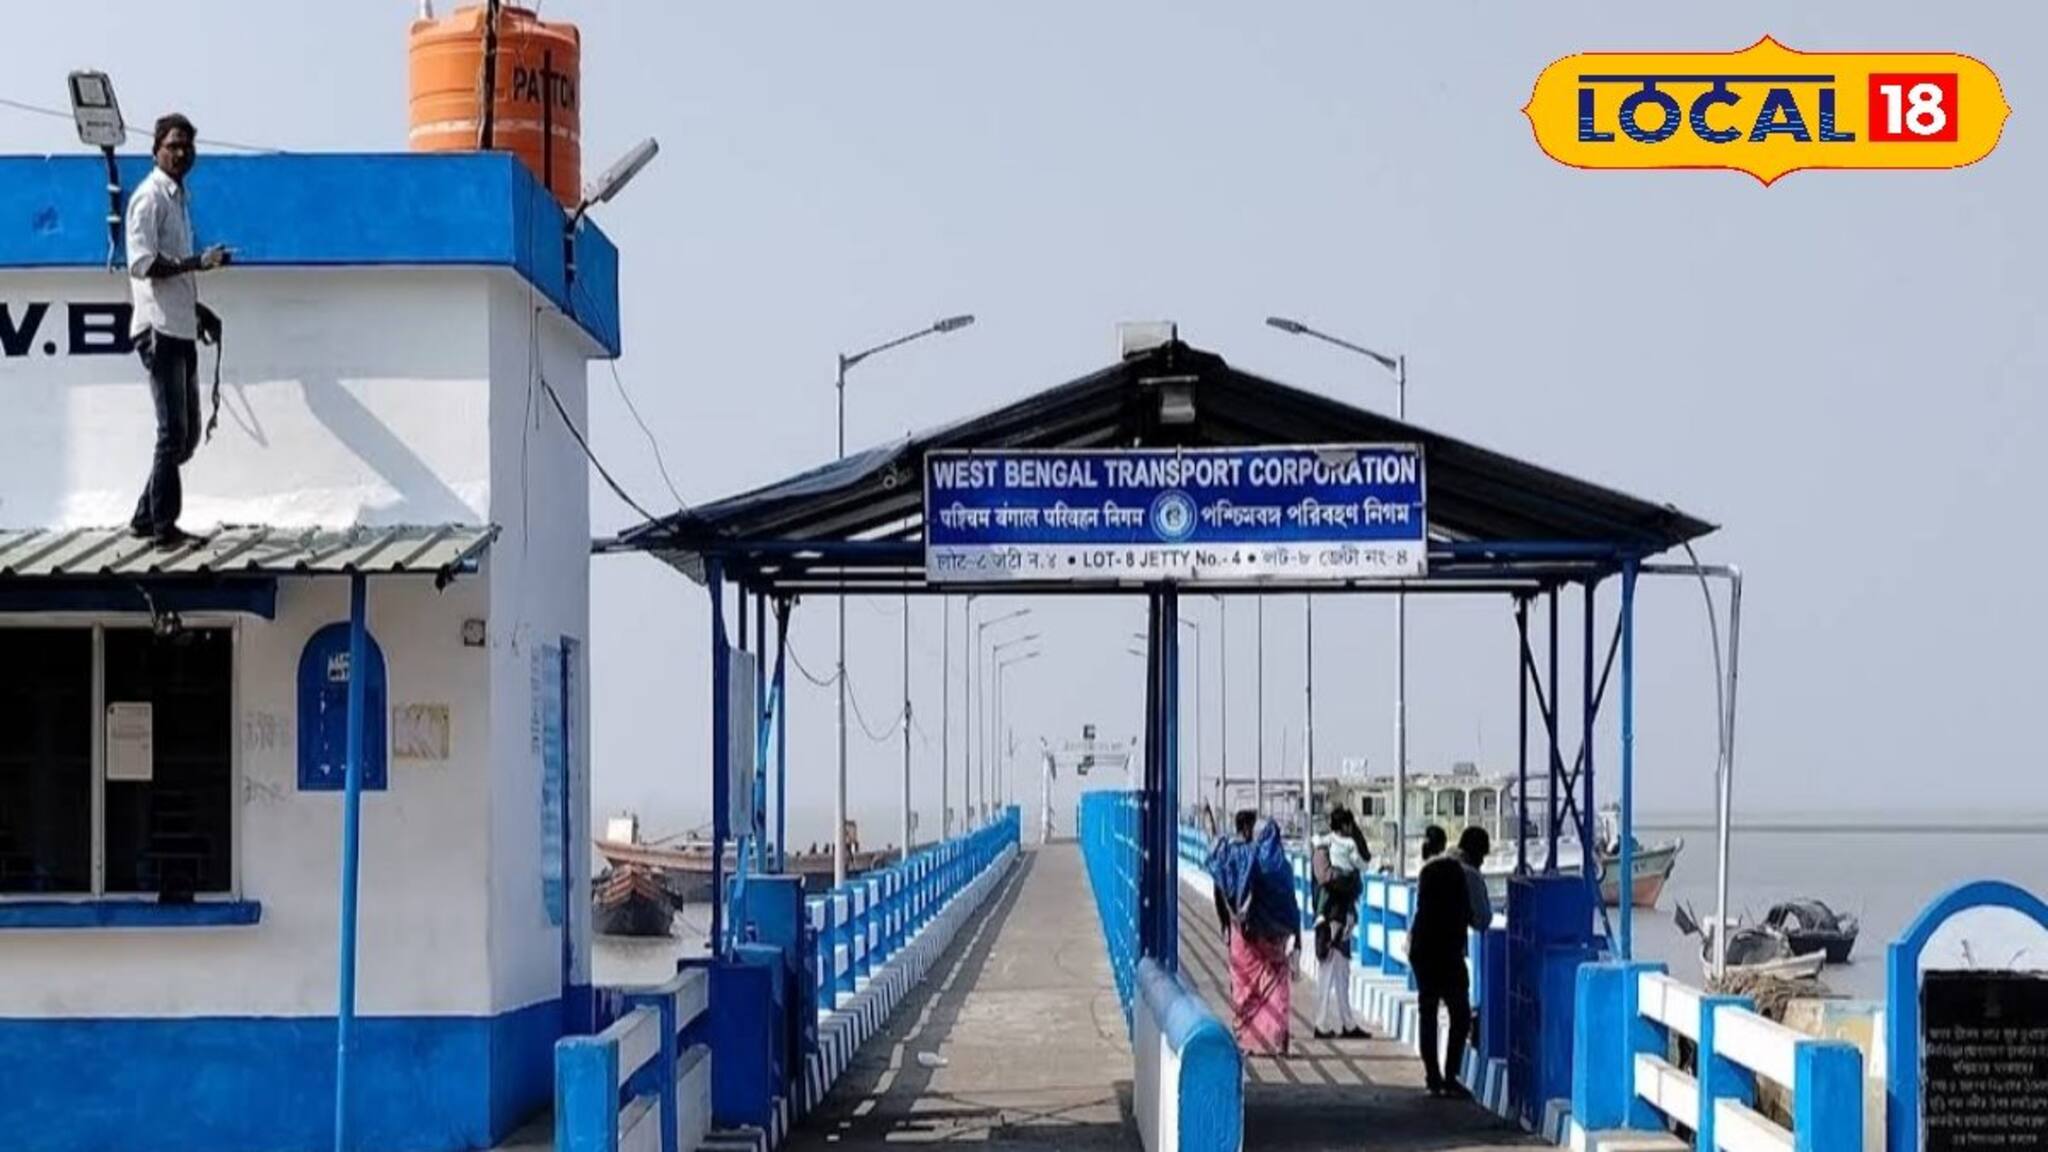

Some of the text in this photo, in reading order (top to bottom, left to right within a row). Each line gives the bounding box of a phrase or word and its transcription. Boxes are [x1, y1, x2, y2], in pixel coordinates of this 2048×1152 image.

[933, 455, 1416, 489] WEST BENGAL TRANSPORT CORPORATION
[1043, 500, 1100, 531] परिवहन
[1103, 499, 1145, 529] निगम
[1363, 496, 1409, 526] নিগম
[1139, 549, 1191, 567] JETTY
